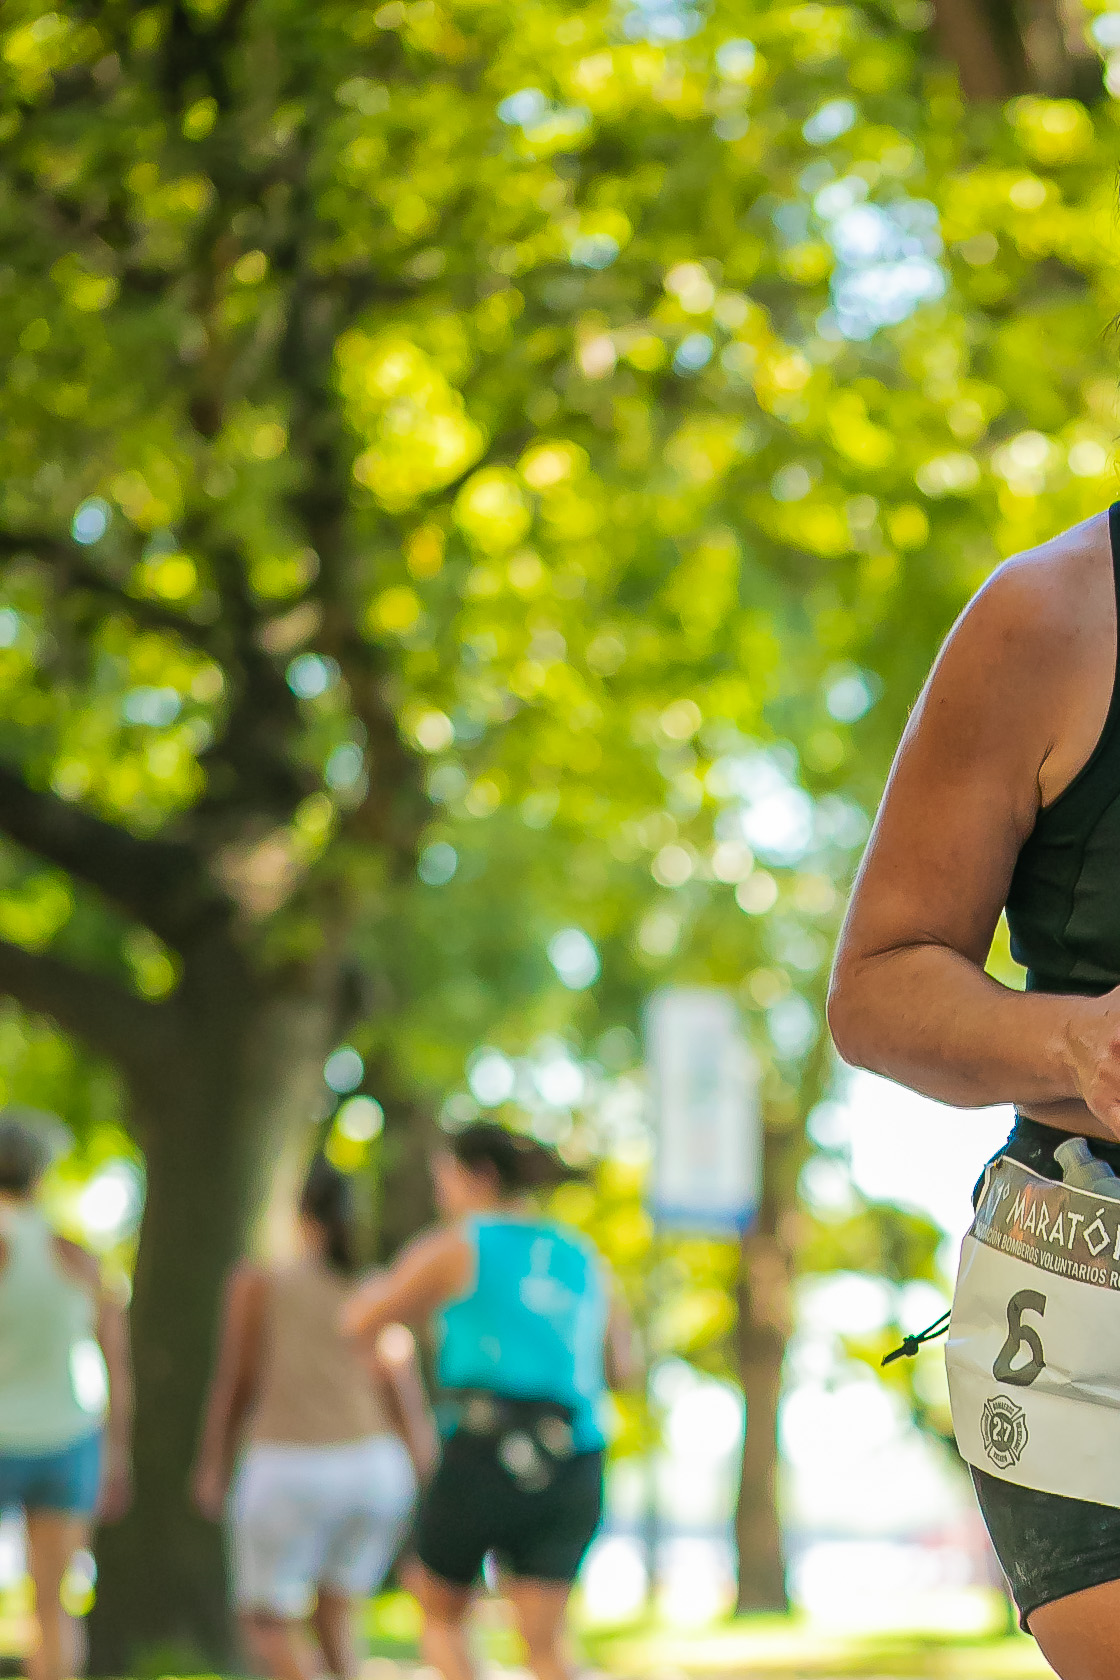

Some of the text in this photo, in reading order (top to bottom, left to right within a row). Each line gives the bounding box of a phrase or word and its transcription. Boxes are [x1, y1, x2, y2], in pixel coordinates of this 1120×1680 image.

[1000, 1233, 1039, 1264] BOMBEROS
[1040, 1248, 1107, 1285] VOLUNTARIOS
[992, 1288, 1047, 1388] 6
[992, 1416, 1012, 1443] 27
